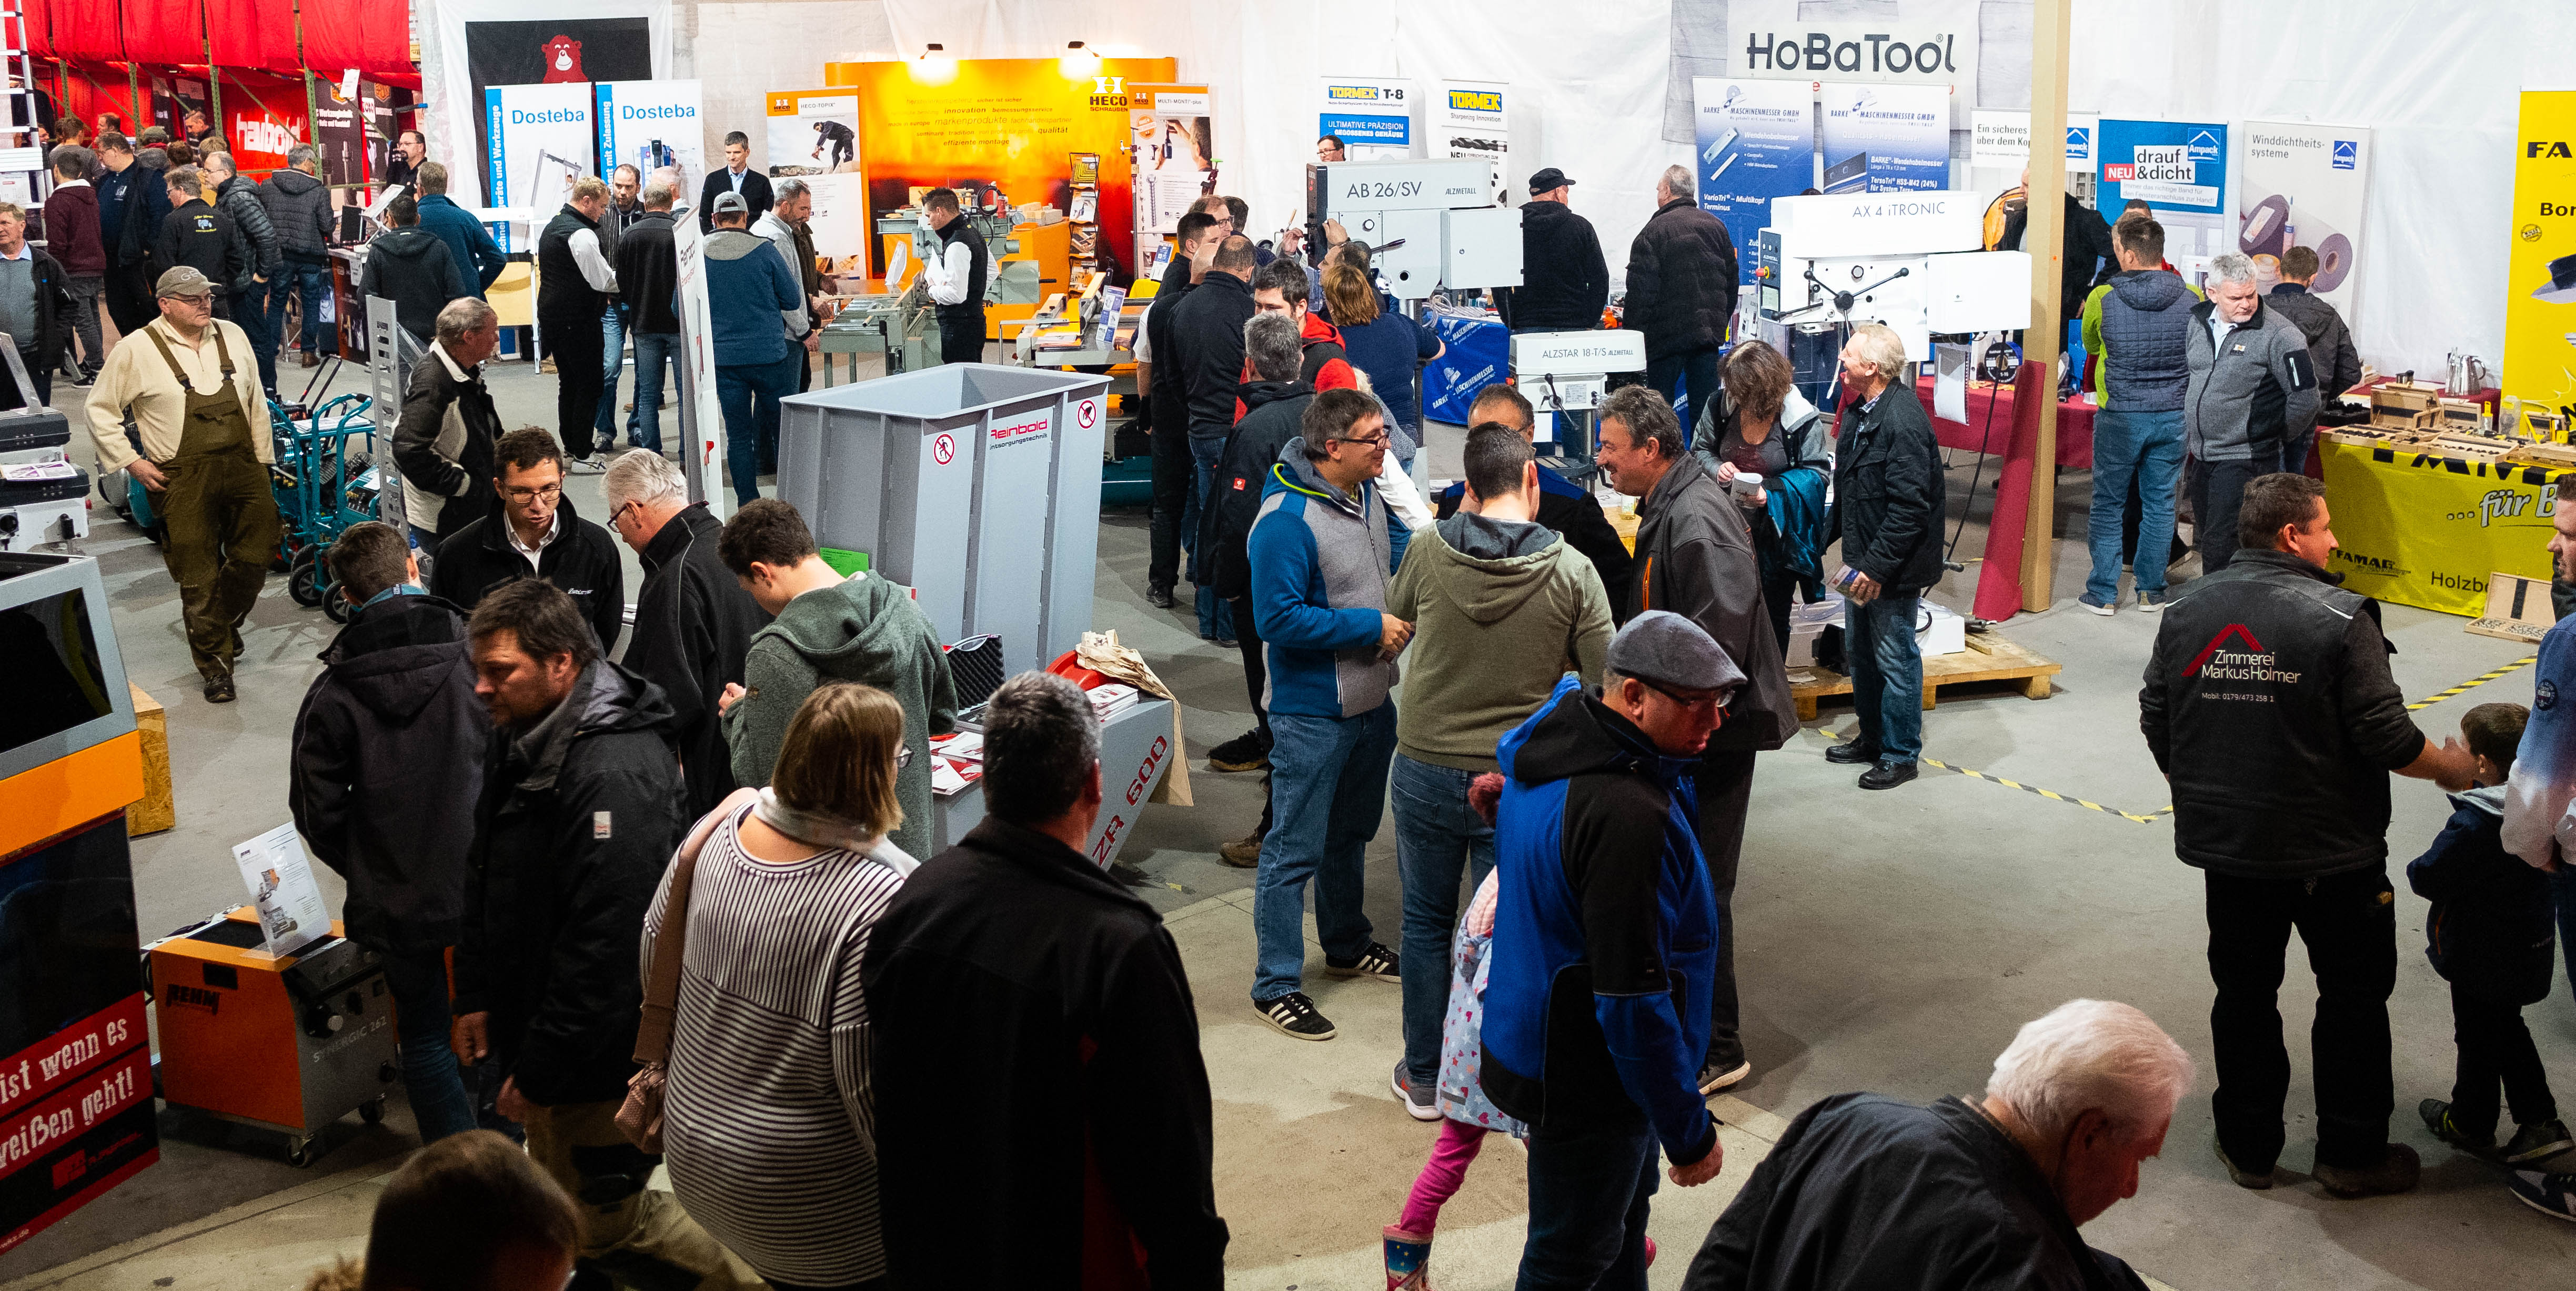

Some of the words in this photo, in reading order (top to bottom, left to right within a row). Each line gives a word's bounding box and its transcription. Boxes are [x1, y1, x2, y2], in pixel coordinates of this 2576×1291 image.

[1330, 87, 1377, 99] TORMEK
[1383, 89, 1403, 99] T-8
[1090, 96, 1128, 106] HECO
[1450, 91, 1501, 111] TORMEK
[512, 108, 585, 124] Dosteba
[623, 104, 695, 119] Dosteba
[1451, 113, 1475, 122] Sharpening
[603, 101, 612, 148] Zulassung
[935, 116, 1007, 126] markenprodukte
[1367, 122, 1404, 130] PRÄZISION
[492, 105, 501, 158] Werkzeuge
[1978, 124, 1989, 133] Ein
[1993, 125, 2027, 134] sicheres
[1744, 132, 1799, 141] Wendehobelmesser
[1977, 136, 1995, 145] über
[1998, 137, 2015, 145] dem
[2252, 135, 2325, 148] Winddichtheits-
[2066, 143, 2088, 152] mpack
[2189, 144, 2218, 156] Ampack
[2251, 149, 2289, 159] systeme
[604, 151, 613, 166] mit
[2137, 149, 2181, 163] drauf
[2334, 154, 2354, 163] Ampack
[494, 161, 502, 178] und
[2108, 167, 2132, 178] NEU
[2137, 165, 2192, 179] &dicht
[1347, 183, 1370, 198] AB
[1374, 181, 1422, 197] 26/SV
[1445, 187, 1477, 195] ALZMETALL
[1920, 179, 1937, 188] (24%)
[2155, 185, 2177, 193] richtige
[1736, 195, 1765, 205] Multikopf
[1853, 206, 1871, 217] AX
[1875, 205, 1883, 216] 4
[1888, 202, 1946, 216] iTRONIC
[1542, 349, 1578, 358] ALZSTAR
[990, 418, 1047, 439] Reinbold
[2336, 549, 2395, 570] FAMAG
[2215, 649, 2275, 666] Zimmerei
[1092, 815, 1125, 868] ZR
[1126, 735, 1168, 806] 600
[370, 1016, 388, 1032] 262
[39, 1033, 100, 1082] wenn
[107, 1018, 128, 1046] es
[82, 1066, 134, 1126] geht!
